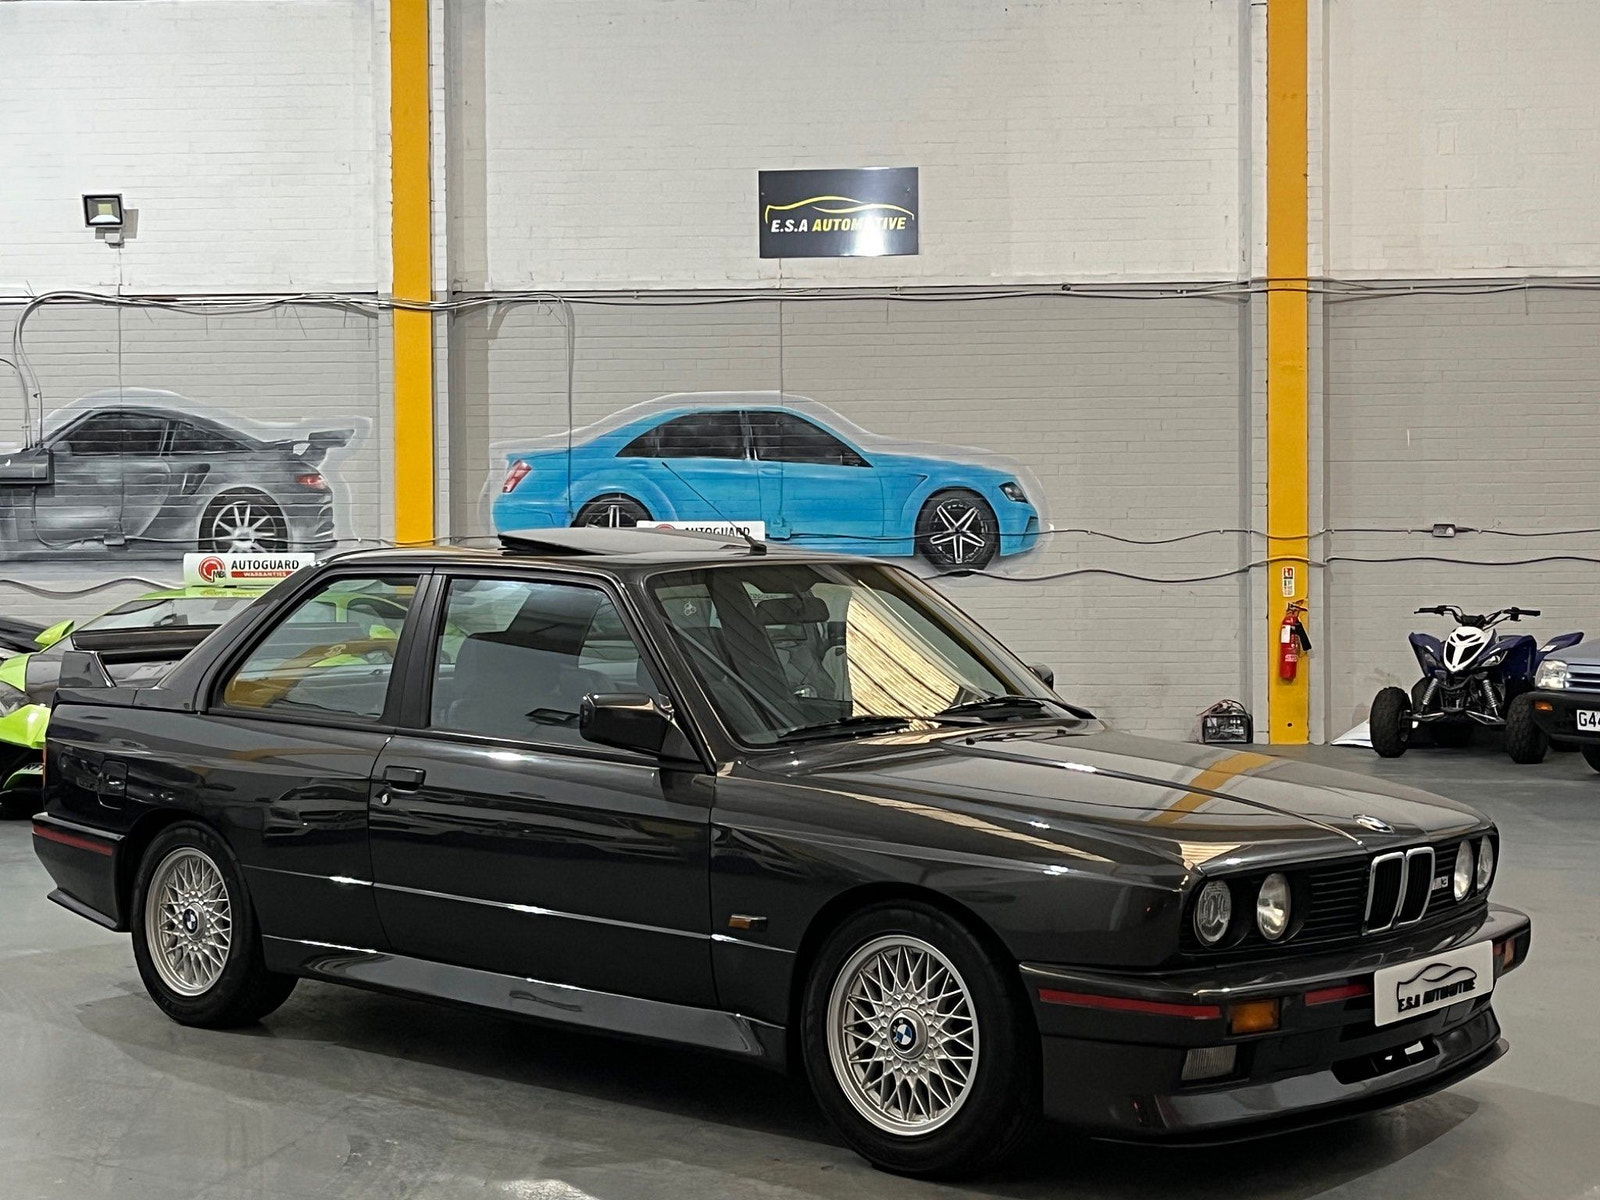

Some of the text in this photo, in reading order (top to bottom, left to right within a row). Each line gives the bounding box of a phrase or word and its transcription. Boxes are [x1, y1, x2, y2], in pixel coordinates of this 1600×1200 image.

[771, 216, 907, 233] E.S.A AUTOMTIVE
[231, 559, 300, 571] AUTOGUARD
[1578, 711, 1600, 728] G4
